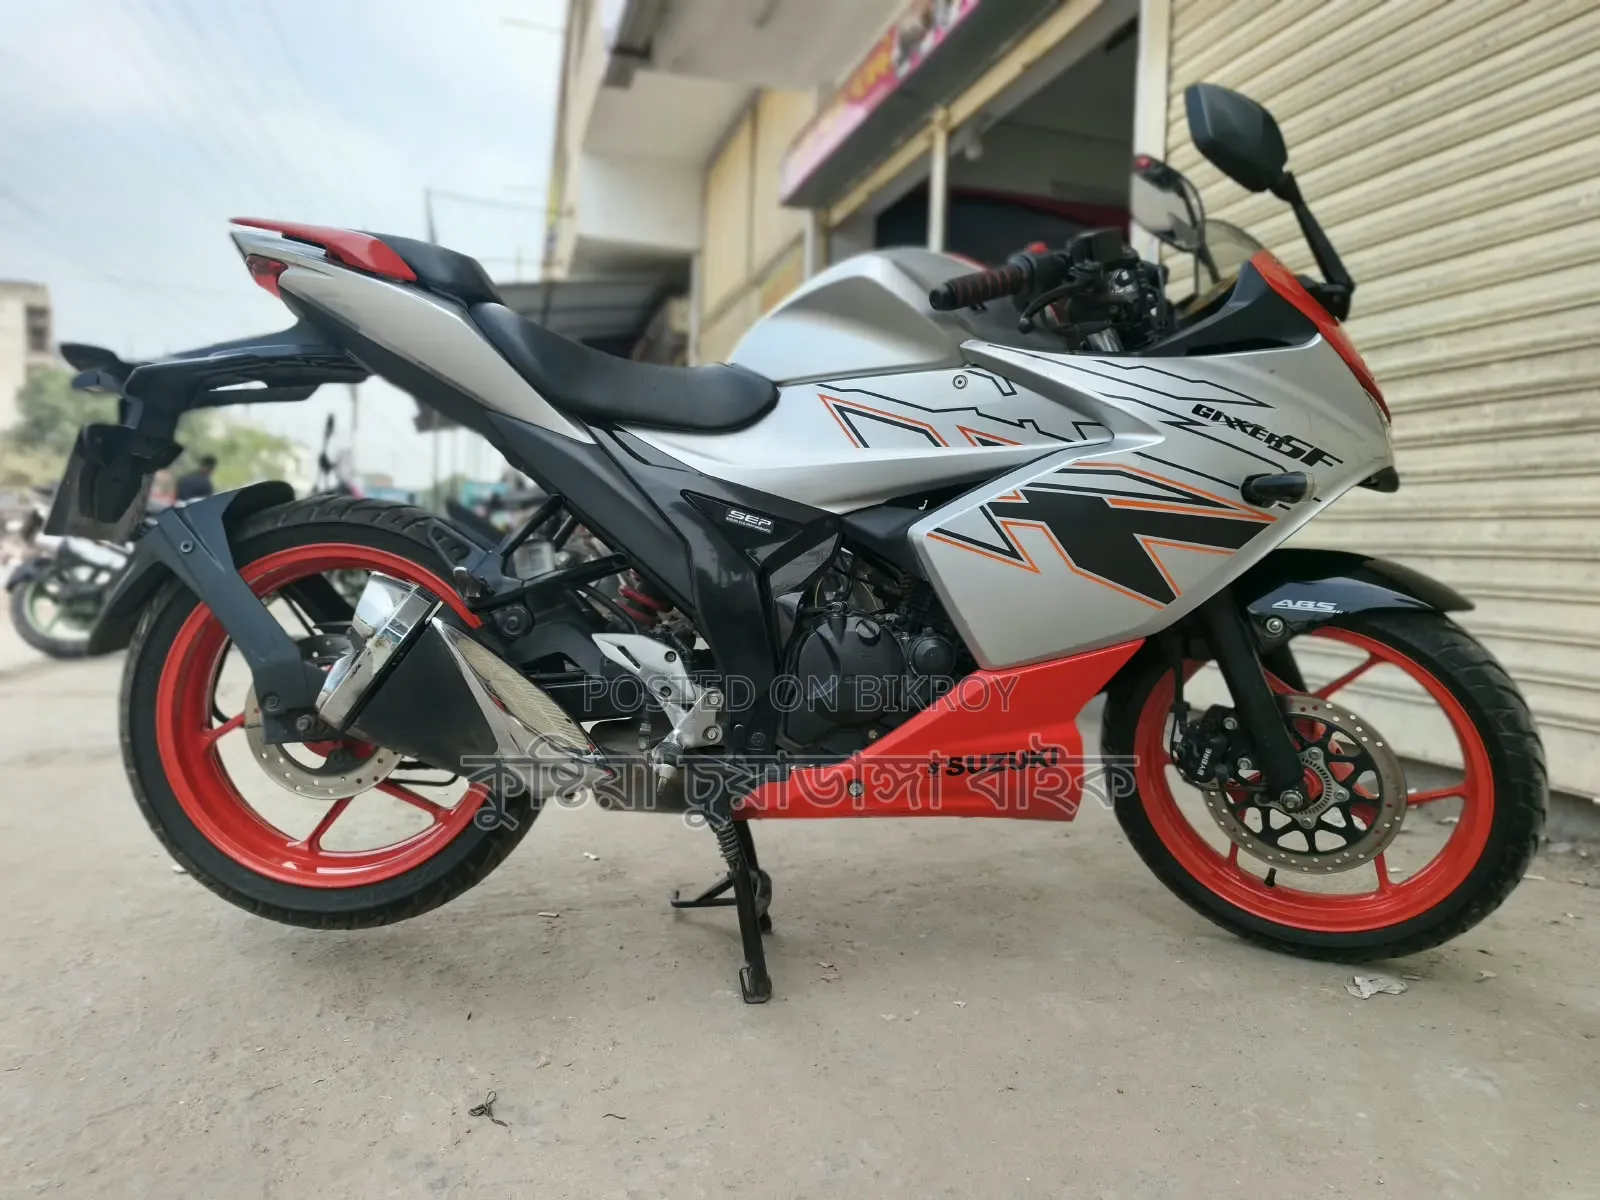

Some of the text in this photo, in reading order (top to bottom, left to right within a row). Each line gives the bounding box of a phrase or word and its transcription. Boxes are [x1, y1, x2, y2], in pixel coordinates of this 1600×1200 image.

[727, 509, 772, 527] SEP
[1272, 599, 1338, 613] ABS
[945, 747, 1058, 777] SUZUKI
[1196, 747, 1213, 777] BYBRE
